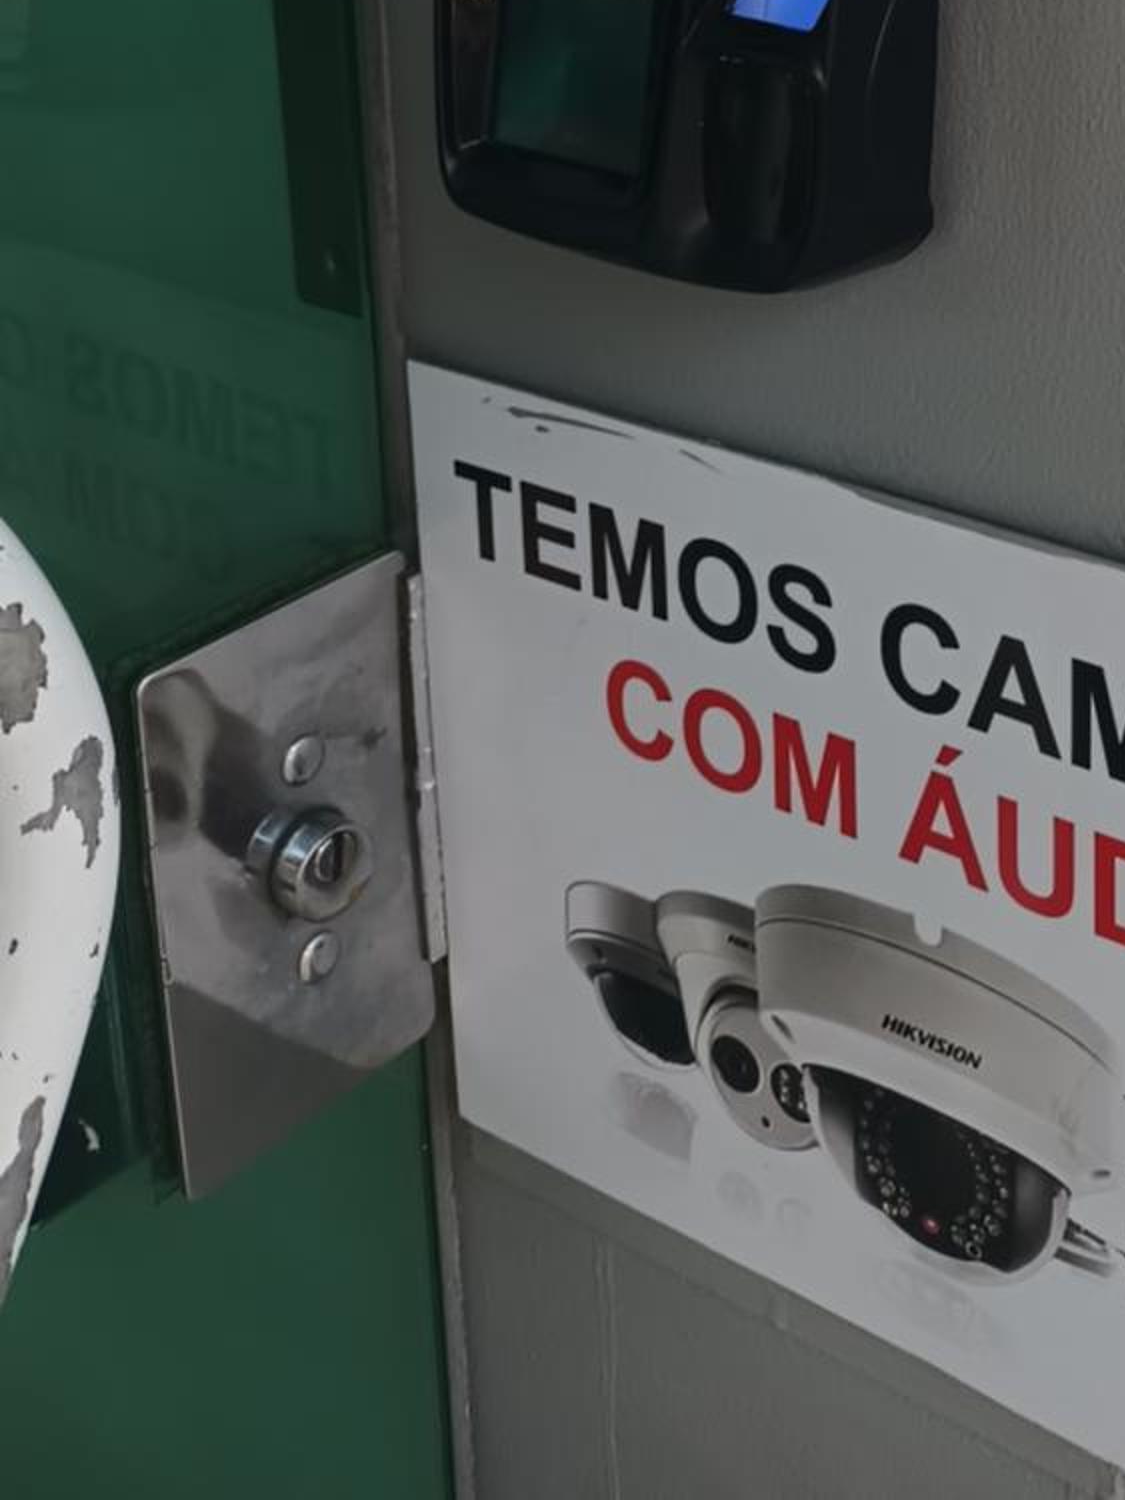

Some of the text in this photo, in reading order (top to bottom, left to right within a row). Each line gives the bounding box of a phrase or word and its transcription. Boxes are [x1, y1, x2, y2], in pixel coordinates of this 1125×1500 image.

[453, 459, 837, 674] TEMOS
[605, 658, 857, 839] COM
[880, 1013, 983, 1070] HIKVISION
